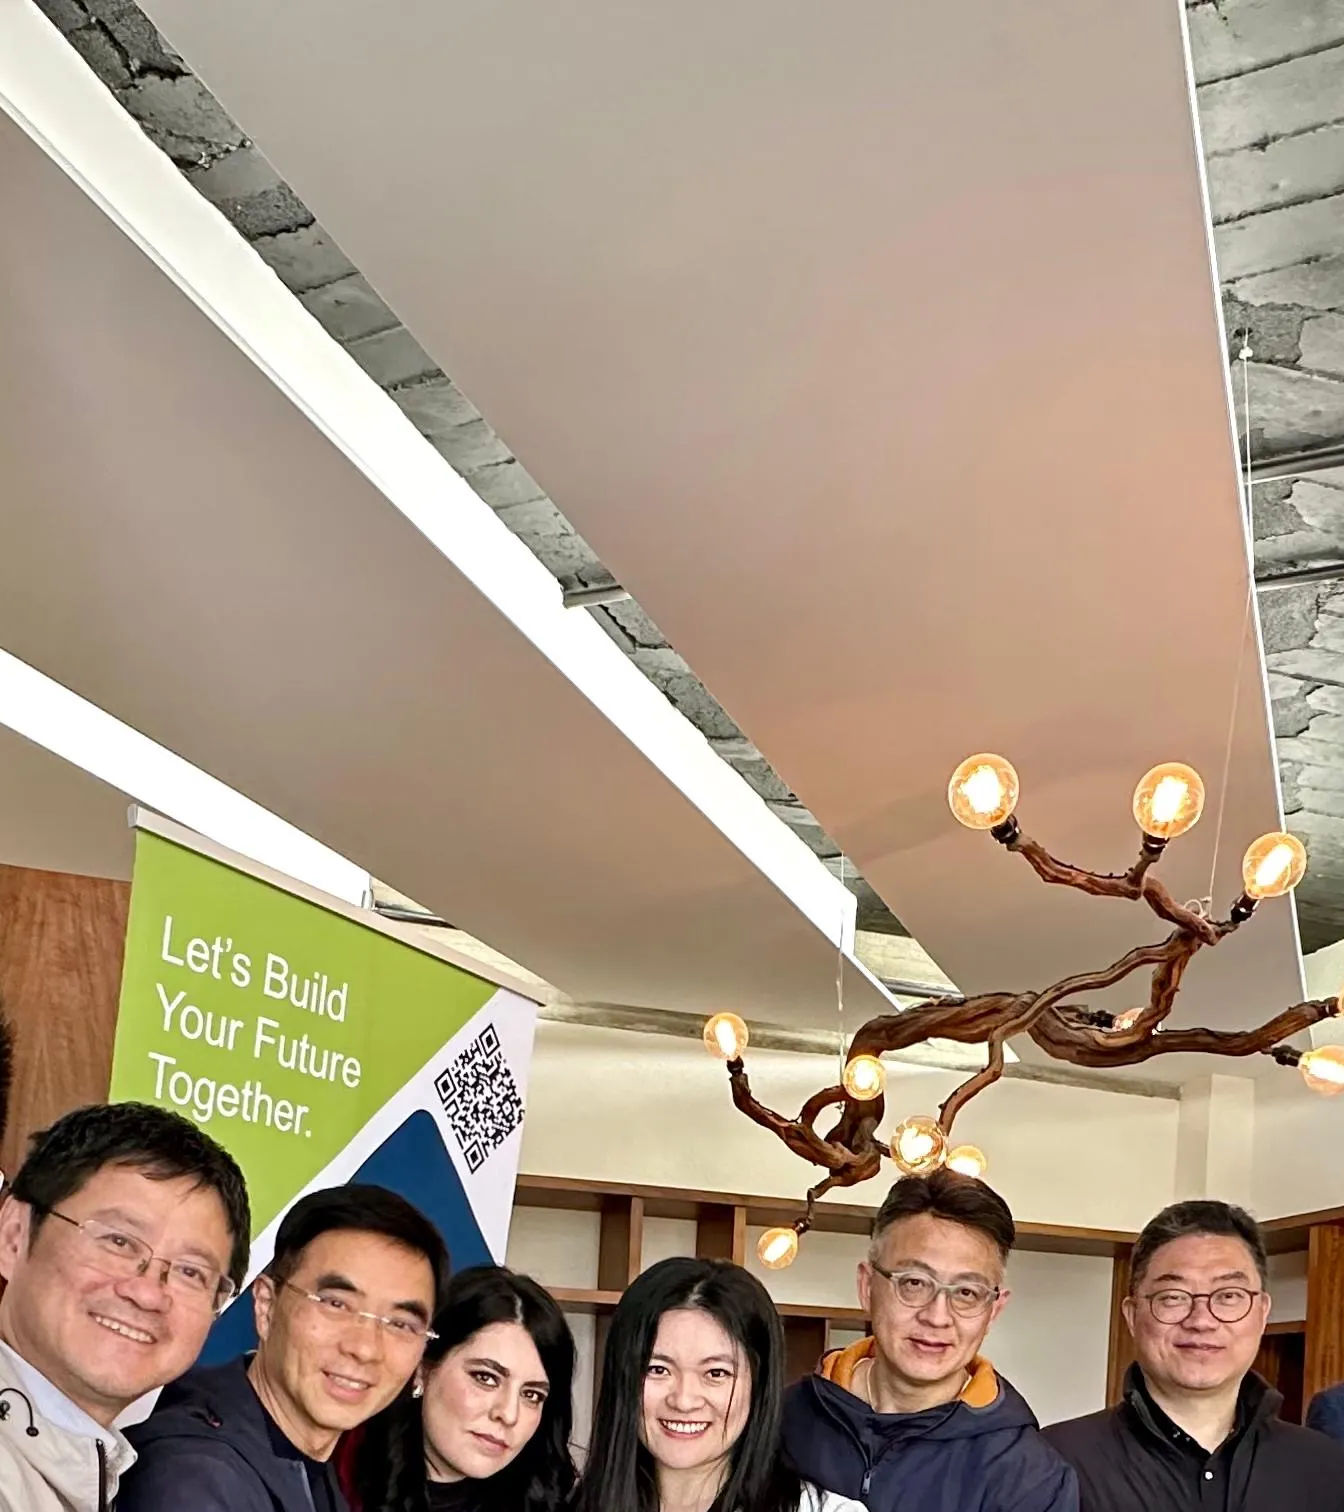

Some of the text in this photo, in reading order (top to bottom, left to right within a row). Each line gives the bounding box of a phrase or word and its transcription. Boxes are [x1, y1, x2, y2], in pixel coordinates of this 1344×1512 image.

[264, 953, 348, 1022] Build
[156, 983, 362, 1088] Your Future
[148, 1052, 313, 1138] Together.
